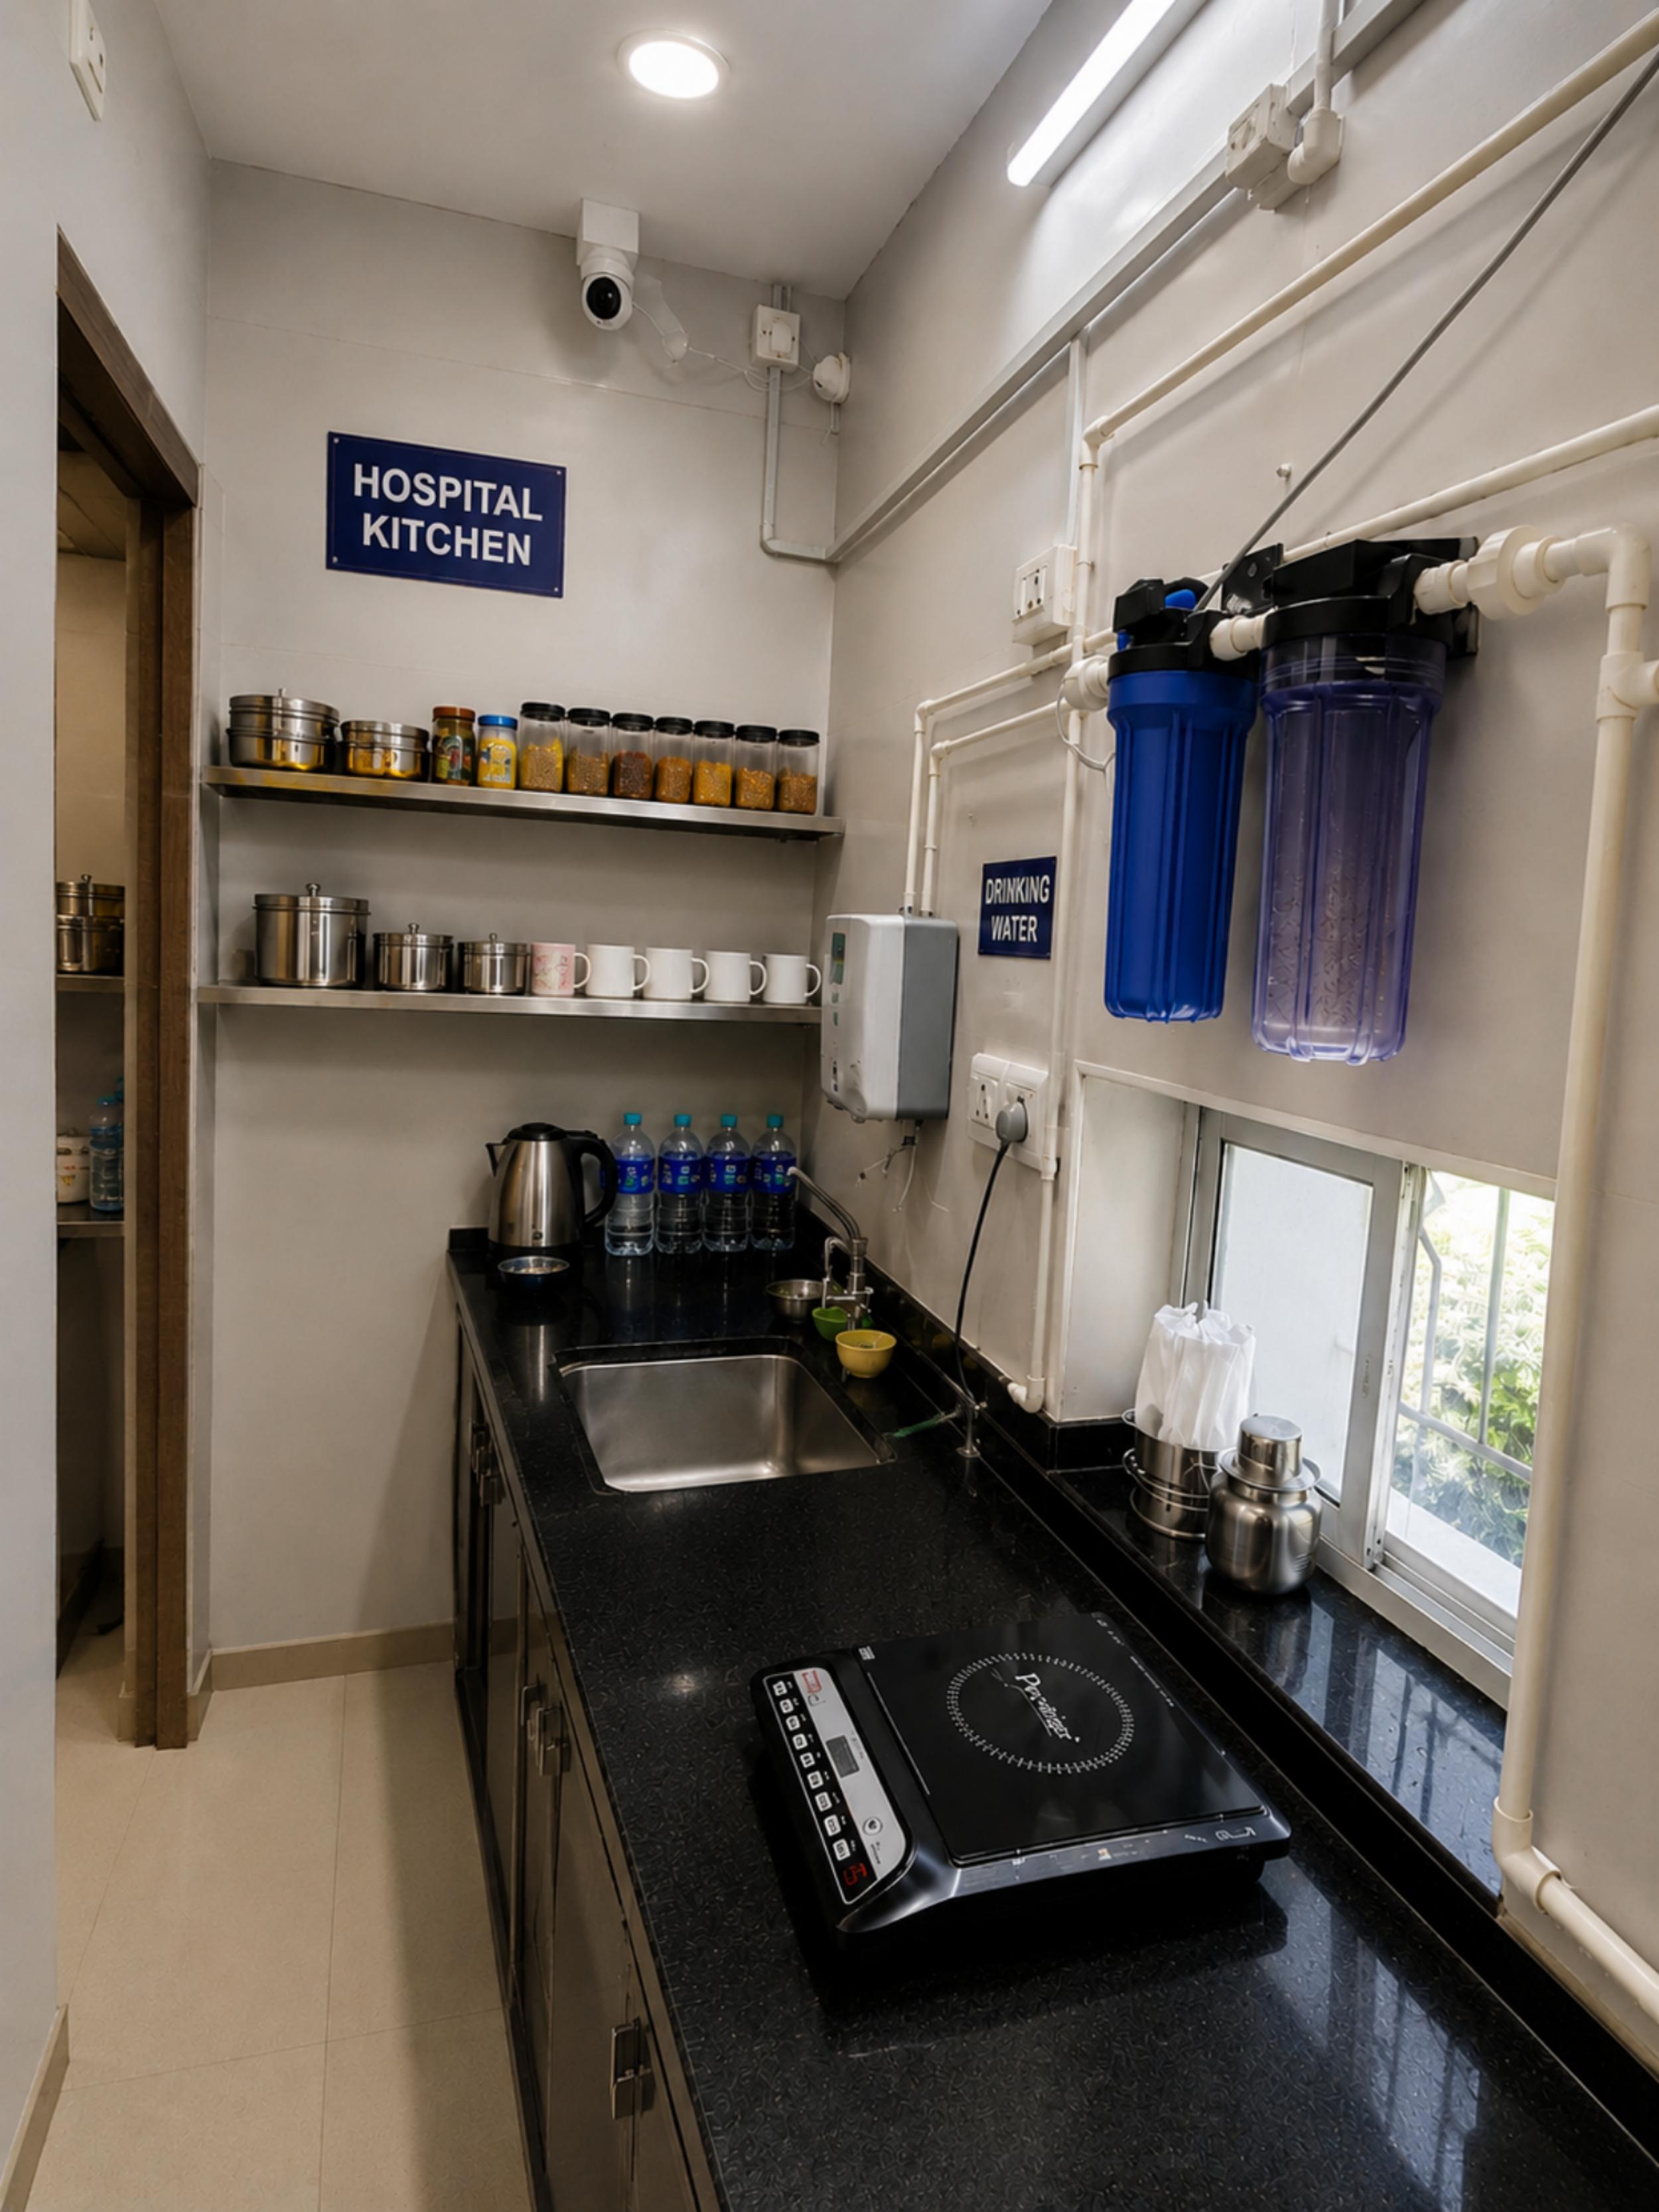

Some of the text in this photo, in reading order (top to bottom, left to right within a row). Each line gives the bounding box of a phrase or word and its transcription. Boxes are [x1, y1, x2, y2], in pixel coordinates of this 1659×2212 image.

[354, 463, 543, 521] HOSPITAL
[363, 512, 531, 565] KITCHEN
[985, 874, 1050, 904] DRINKING
[991, 916, 1038, 942] WATER
